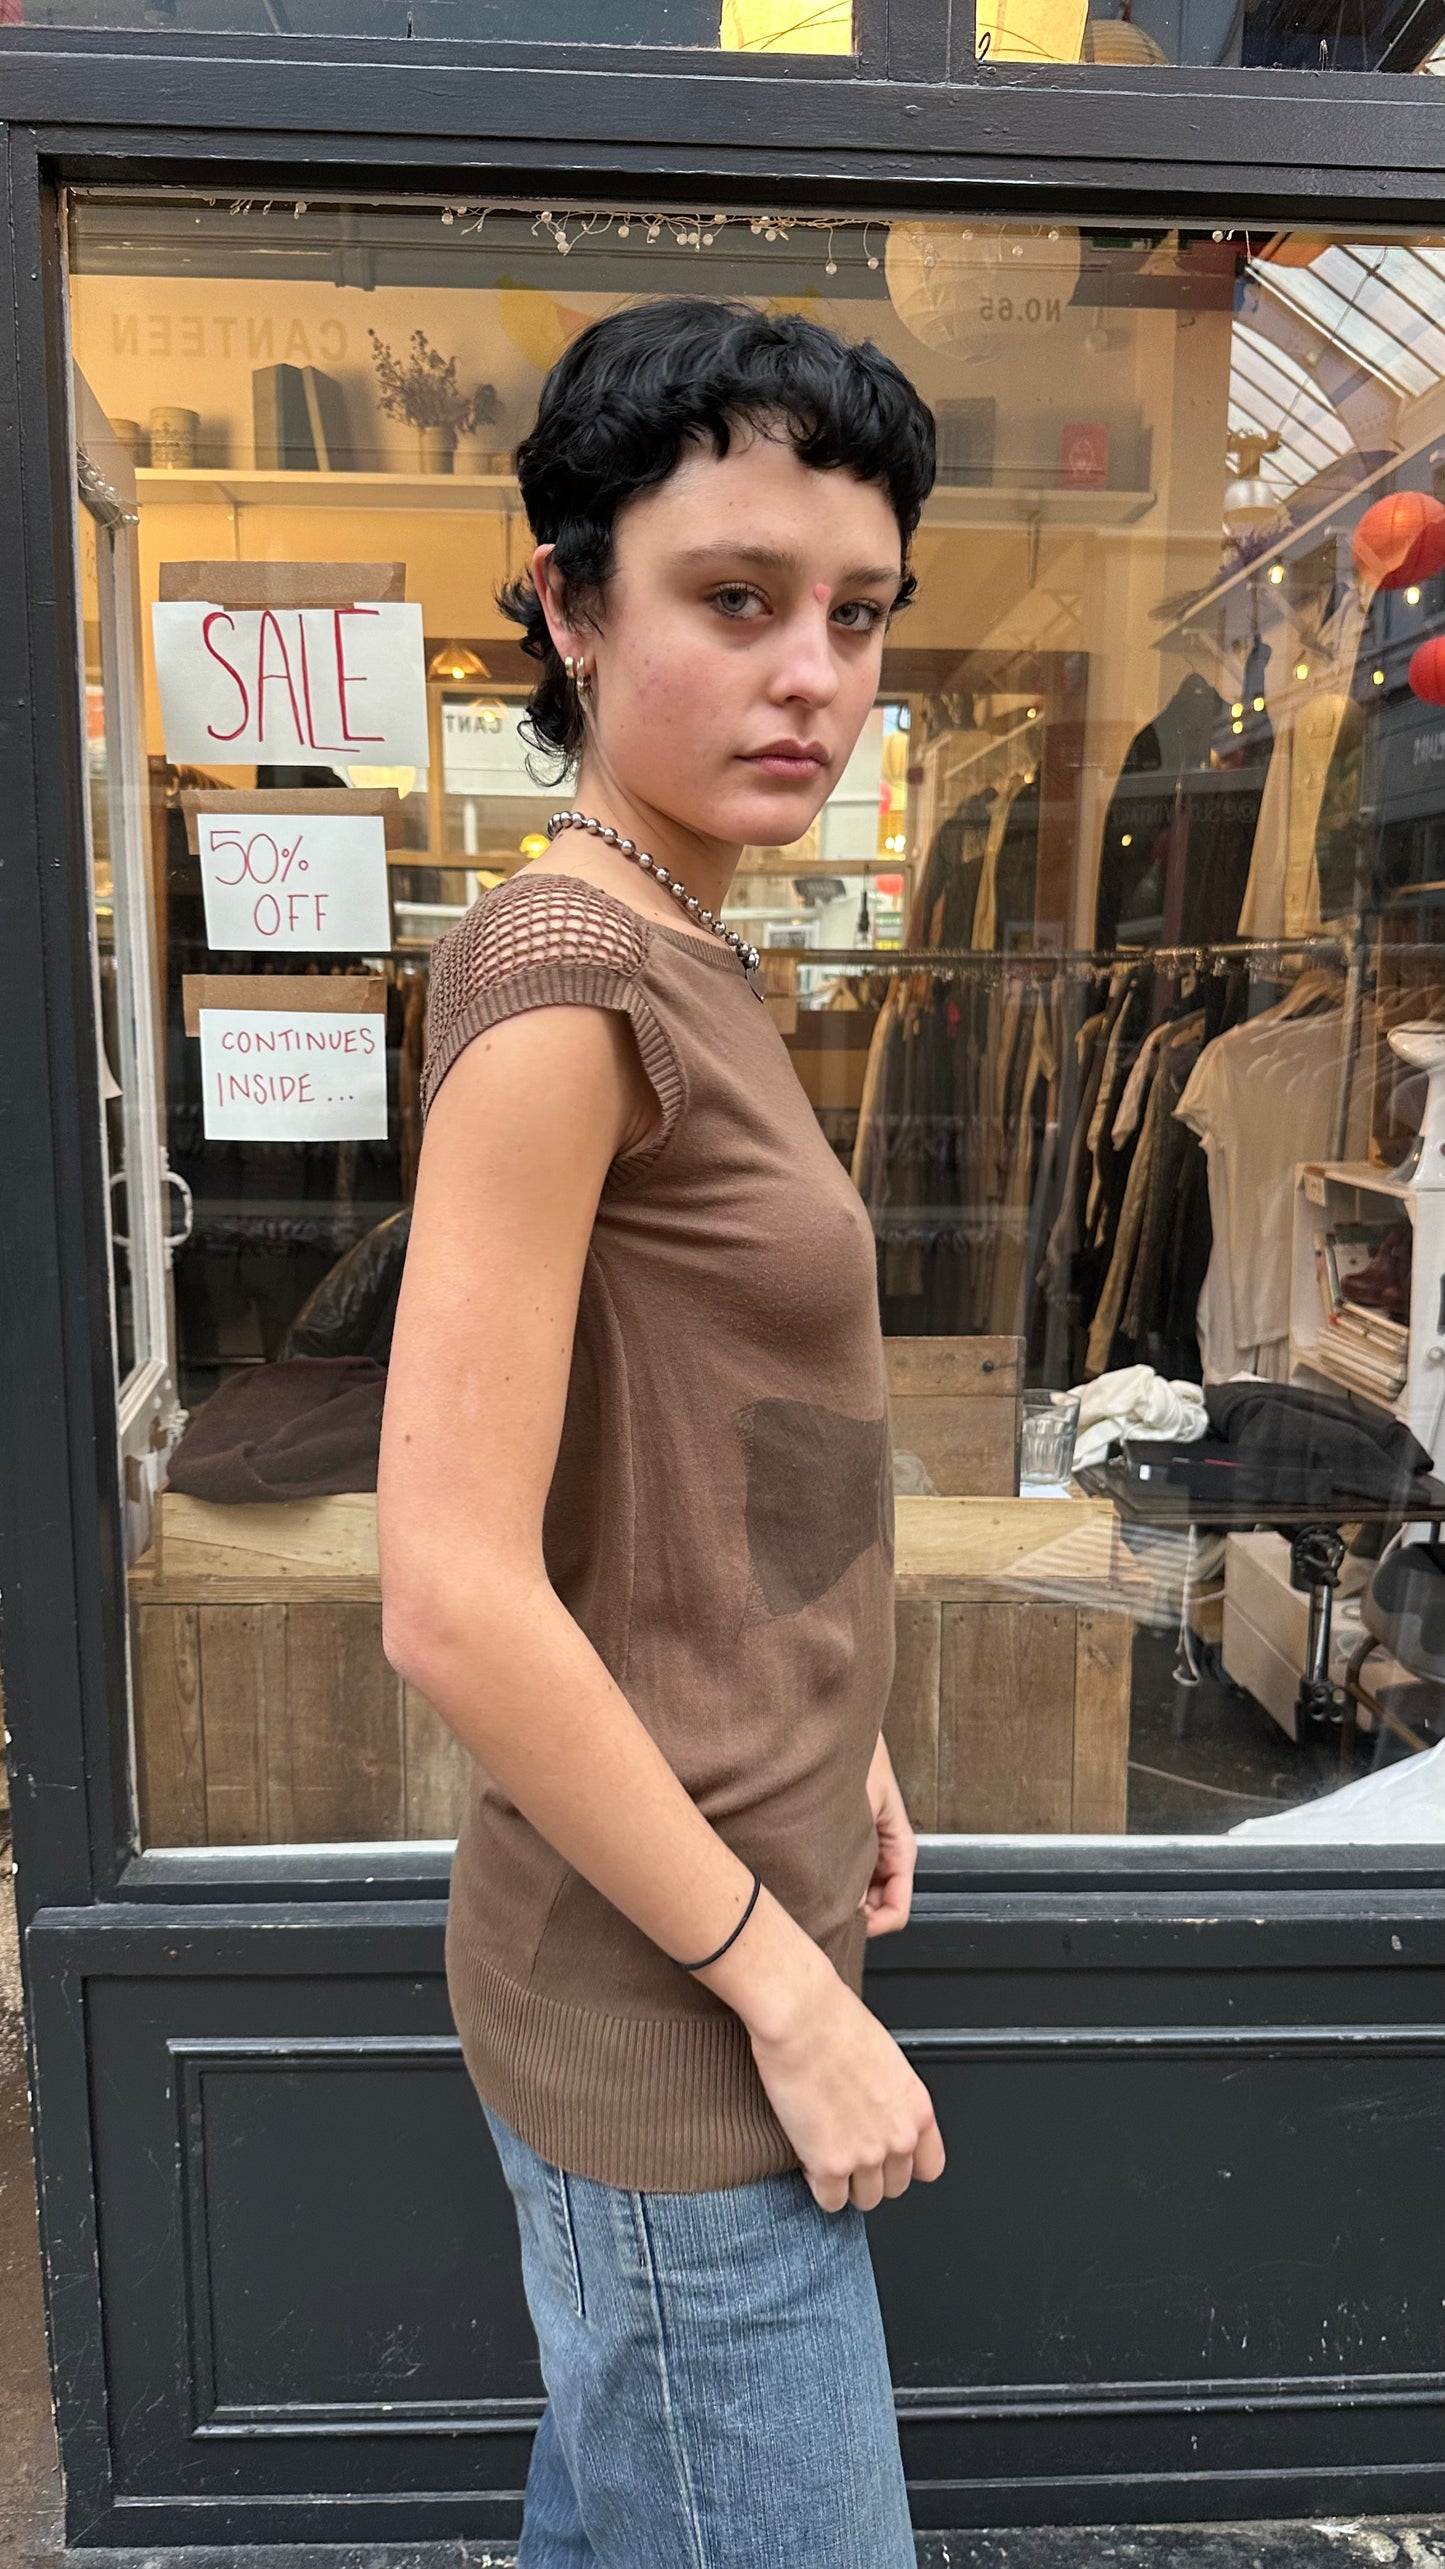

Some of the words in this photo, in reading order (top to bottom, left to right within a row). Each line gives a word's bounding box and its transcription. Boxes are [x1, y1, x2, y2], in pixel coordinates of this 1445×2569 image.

[203, 608, 385, 753] SALE
[210, 830, 309, 886] 50%
[254, 893, 329, 936] OFF
[222, 1028, 376, 1055] CONTINUES
